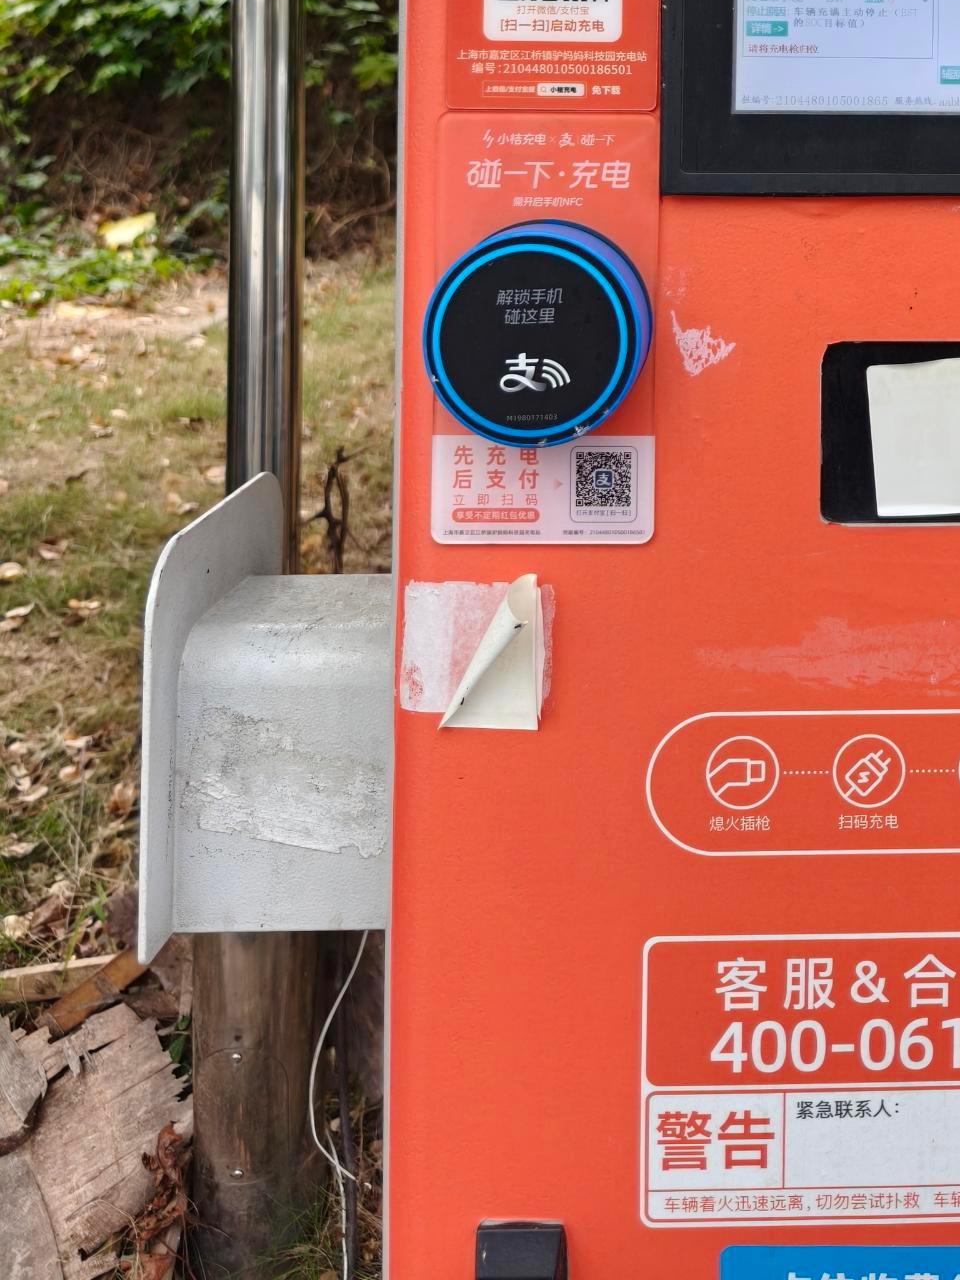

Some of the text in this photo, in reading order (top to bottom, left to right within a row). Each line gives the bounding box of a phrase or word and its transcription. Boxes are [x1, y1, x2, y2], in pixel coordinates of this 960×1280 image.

[516, 5, 590, 16] 打开微信/支付宝
[500, 19, 605, 33] [扫一扫]启动充电
[456, 50, 648, 63] 上海市嘉定区江桥镇驴妈妈科技园充电站
[591, 85, 621, 96] 免下载
[497, 134, 546, 146] 小桔充电
[580, 134, 616, 146] 碰一下
[496, 287, 563, 306] 解锁手机
[504, 307, 555, 325] 碰这里
[454, 445, 539, 466] 先充电
[453, 469, 539, 490] 后支付
[453, 493, 538, 506] 立即扫码
[709, 815, 771, 832] 熄火插枪
[837, 814, 899, 830] 扫码充电
[657, 1110, 776, 1172] 警告
